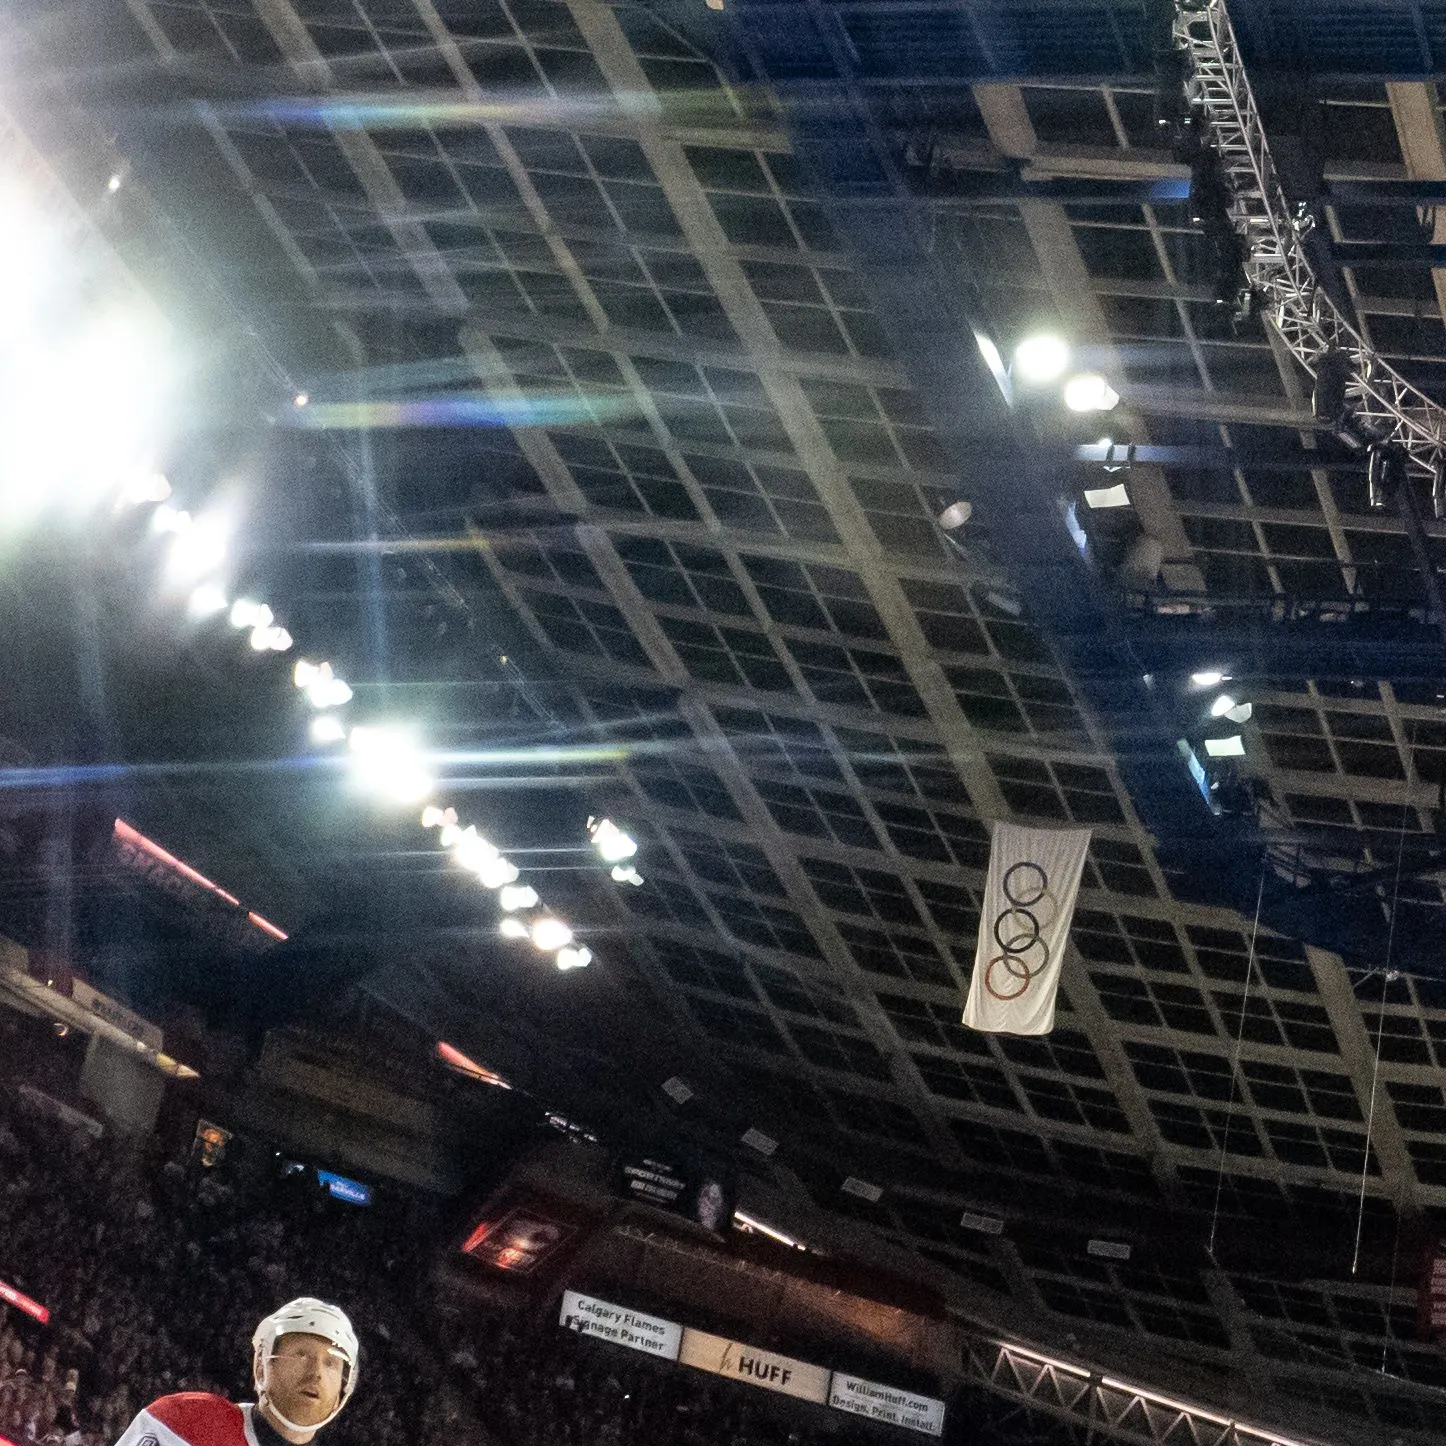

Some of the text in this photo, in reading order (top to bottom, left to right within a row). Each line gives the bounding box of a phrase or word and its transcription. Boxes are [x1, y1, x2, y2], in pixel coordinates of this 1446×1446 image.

[577, 1299, 666, 1336] Calgary Flames
[620, 1328, 665, 1351] Partner
[738, 1356, 792, 1386] HUFF
